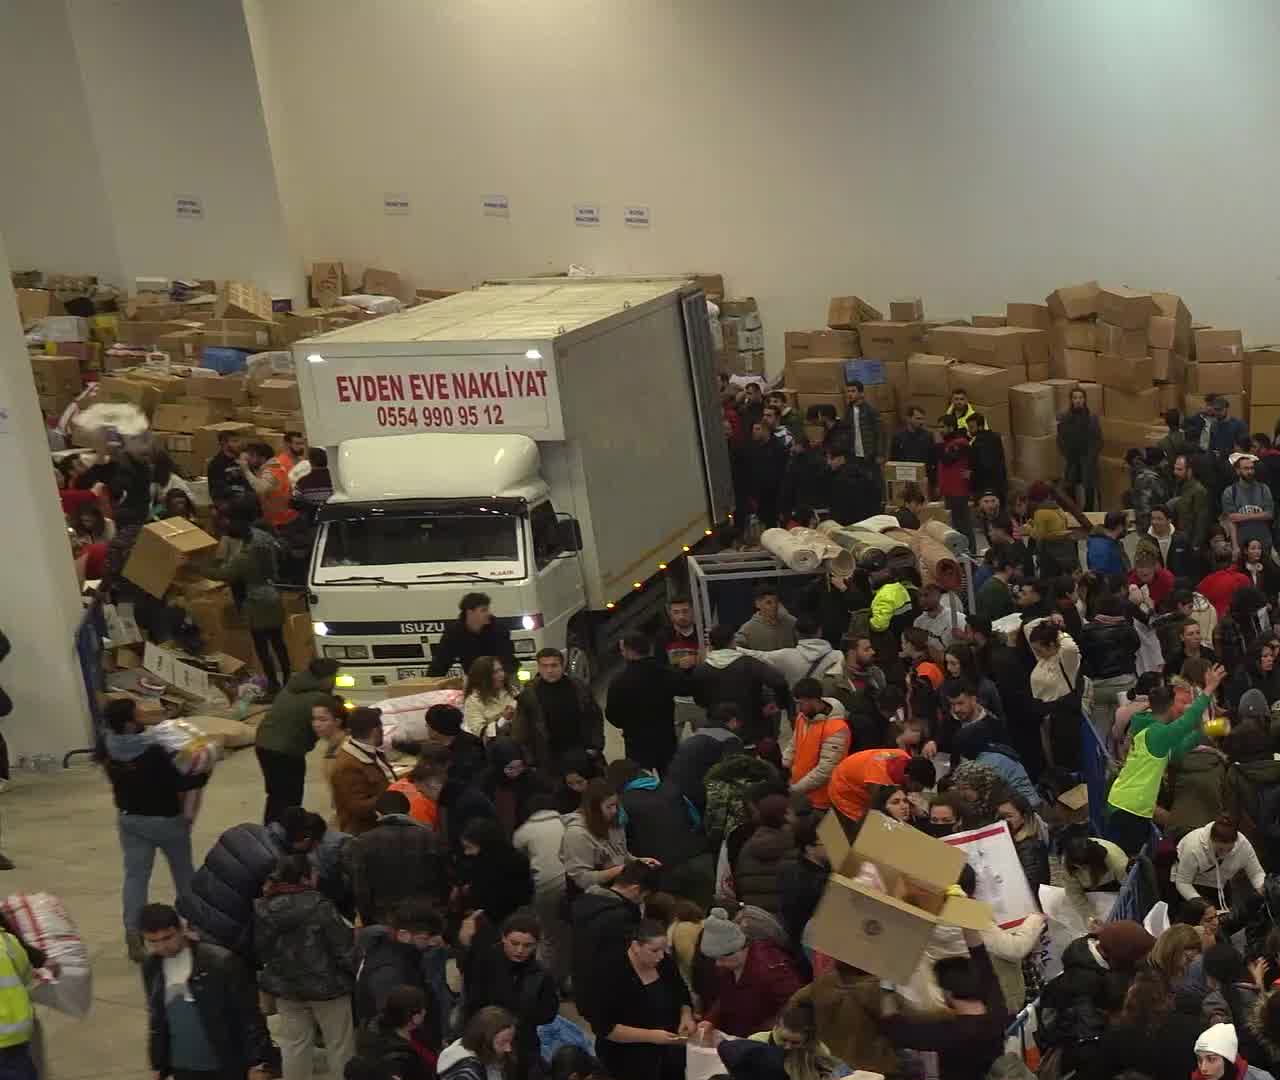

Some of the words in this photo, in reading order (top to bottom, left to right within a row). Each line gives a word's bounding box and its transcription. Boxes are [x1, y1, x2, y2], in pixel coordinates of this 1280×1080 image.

[336, 375, 403, 402] EVDEN
[409, 374, 449, 400] EVE
[452, 365, 548, 399] NAKLİYAT
[377, 405, 418, 427] 0554
[422, 405, 453, 426] 990
[458, 405, 479, 425] 95
[483, 404, 504, 425] 12
[400, 622, 446, 634] ISUZU
